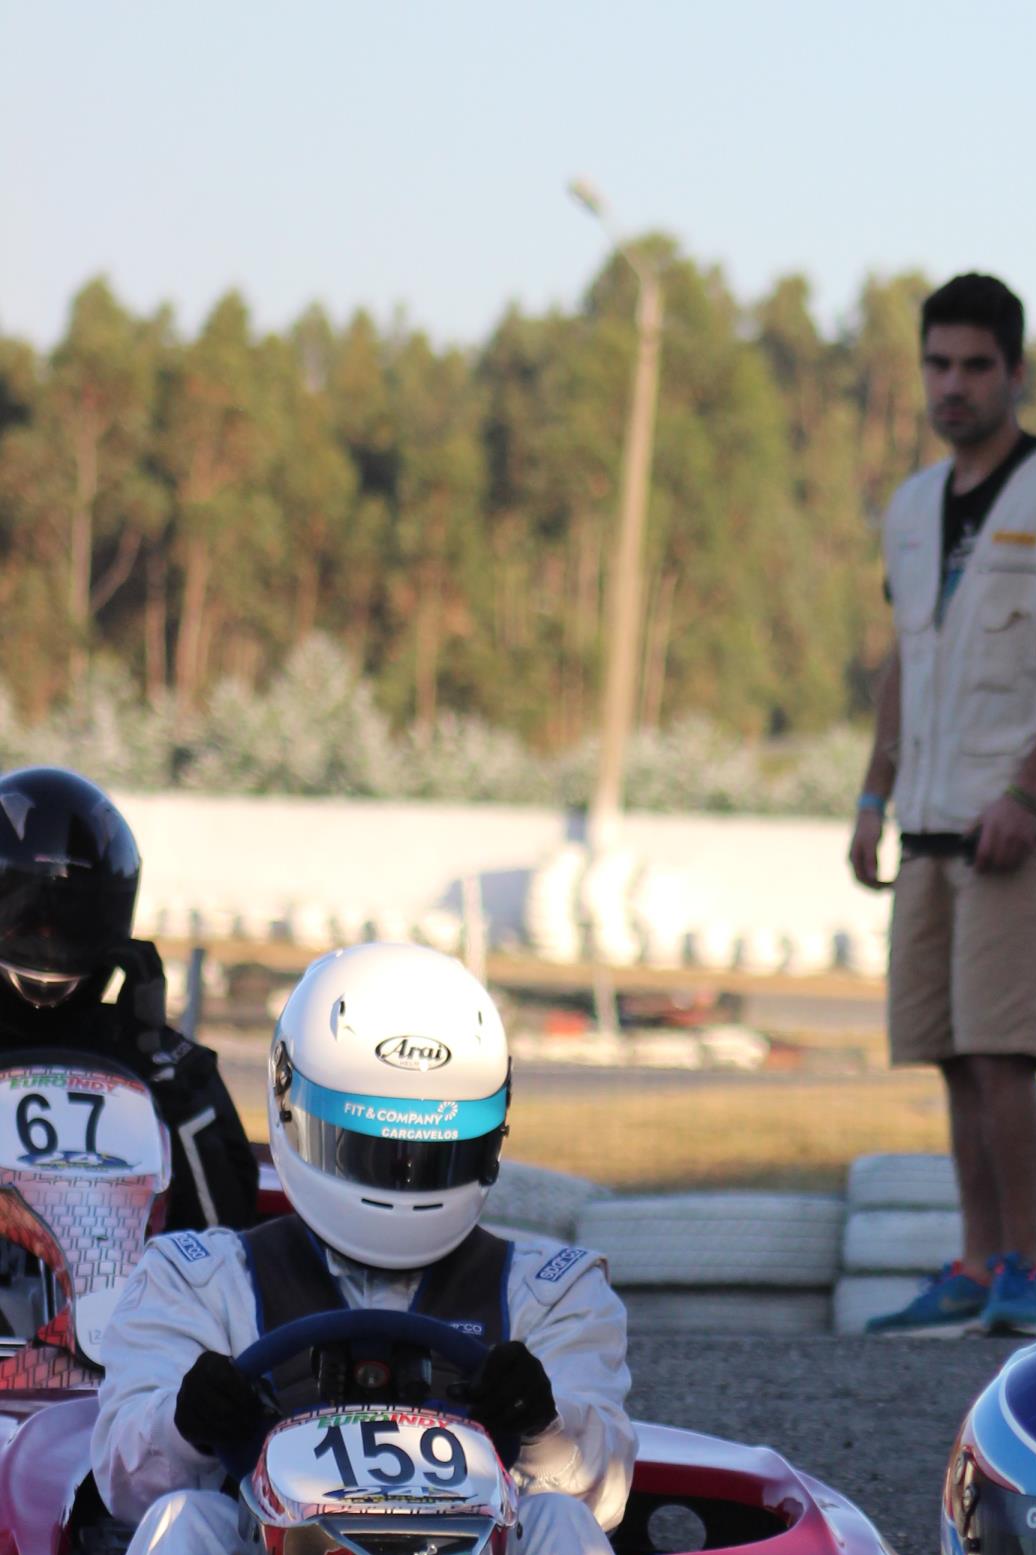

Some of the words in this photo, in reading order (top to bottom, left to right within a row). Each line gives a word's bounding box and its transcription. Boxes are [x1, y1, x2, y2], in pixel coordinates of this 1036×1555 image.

[381, 1039, 444, 1060] Arai
[10, 1075, 116, 1093] EUROINDY
[16, 1091, 106, 1155] 67
[344, 1102, 365, 1117] FIT
[366, 1107, 376, 1120] &
[377, 1109, 444, 1125] COMPANY
[381, 1127, 458, 1140] CARCAVELOS
[313, 1420, 468, 1488] 159
